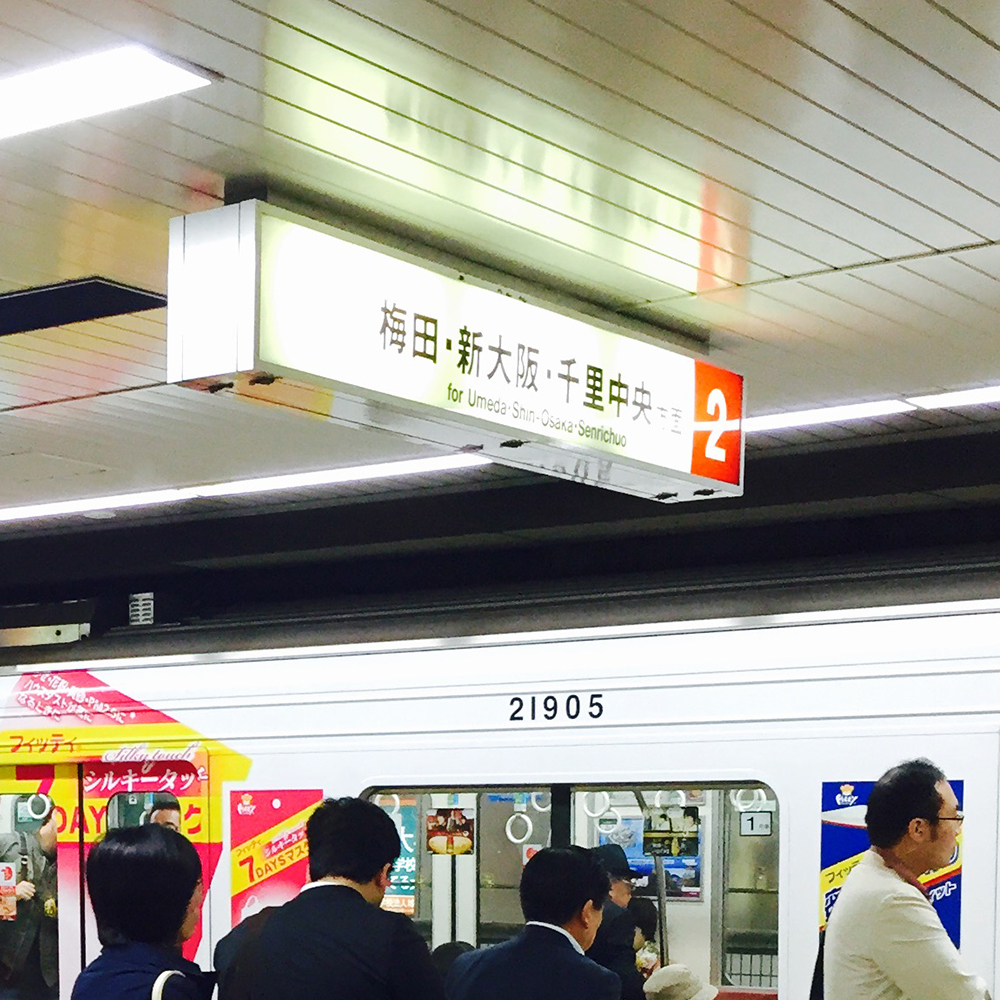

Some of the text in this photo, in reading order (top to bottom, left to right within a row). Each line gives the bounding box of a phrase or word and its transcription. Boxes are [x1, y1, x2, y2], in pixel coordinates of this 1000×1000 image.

[447, 383, 464, 404] for
[705, 388, 727, 462] 2
[509, 694, 604, 721] 21905
[9, 734, 78, 753] フィッティ
[83, 767, 209, 793] シルキータッチ
